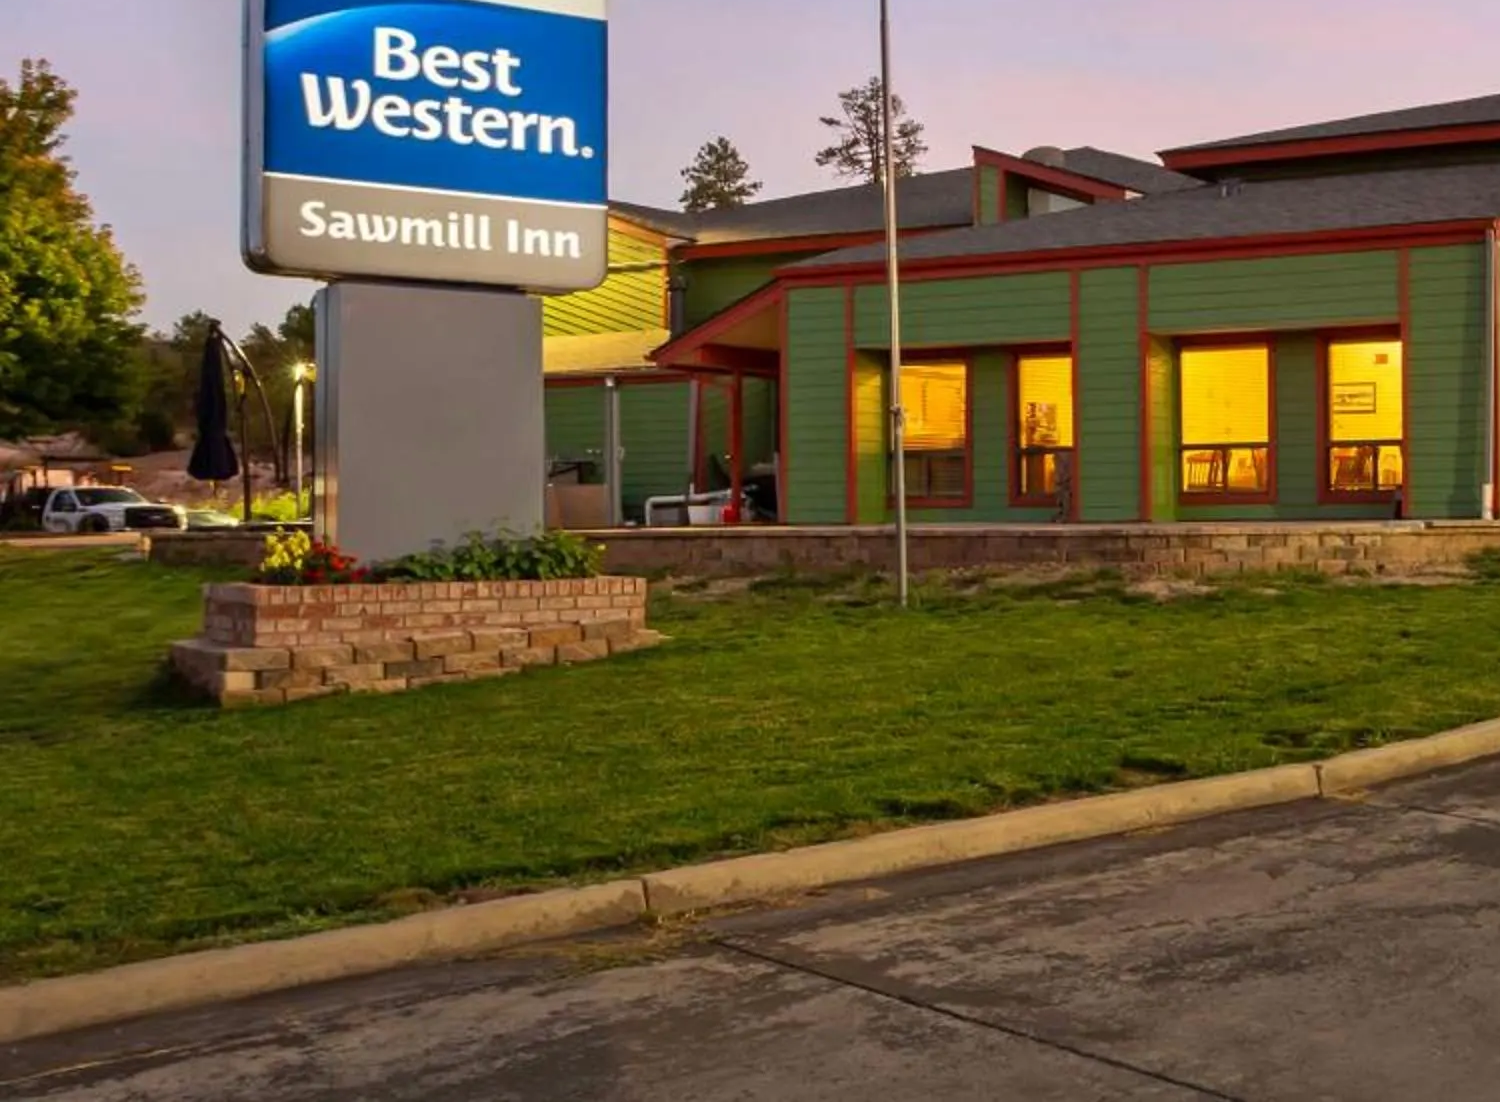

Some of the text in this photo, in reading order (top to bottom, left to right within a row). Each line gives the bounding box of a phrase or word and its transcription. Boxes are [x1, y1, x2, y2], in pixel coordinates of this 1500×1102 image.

[373, 26, 522, 96] Best
[299, 201, 582, 258] Sawmill Inn
